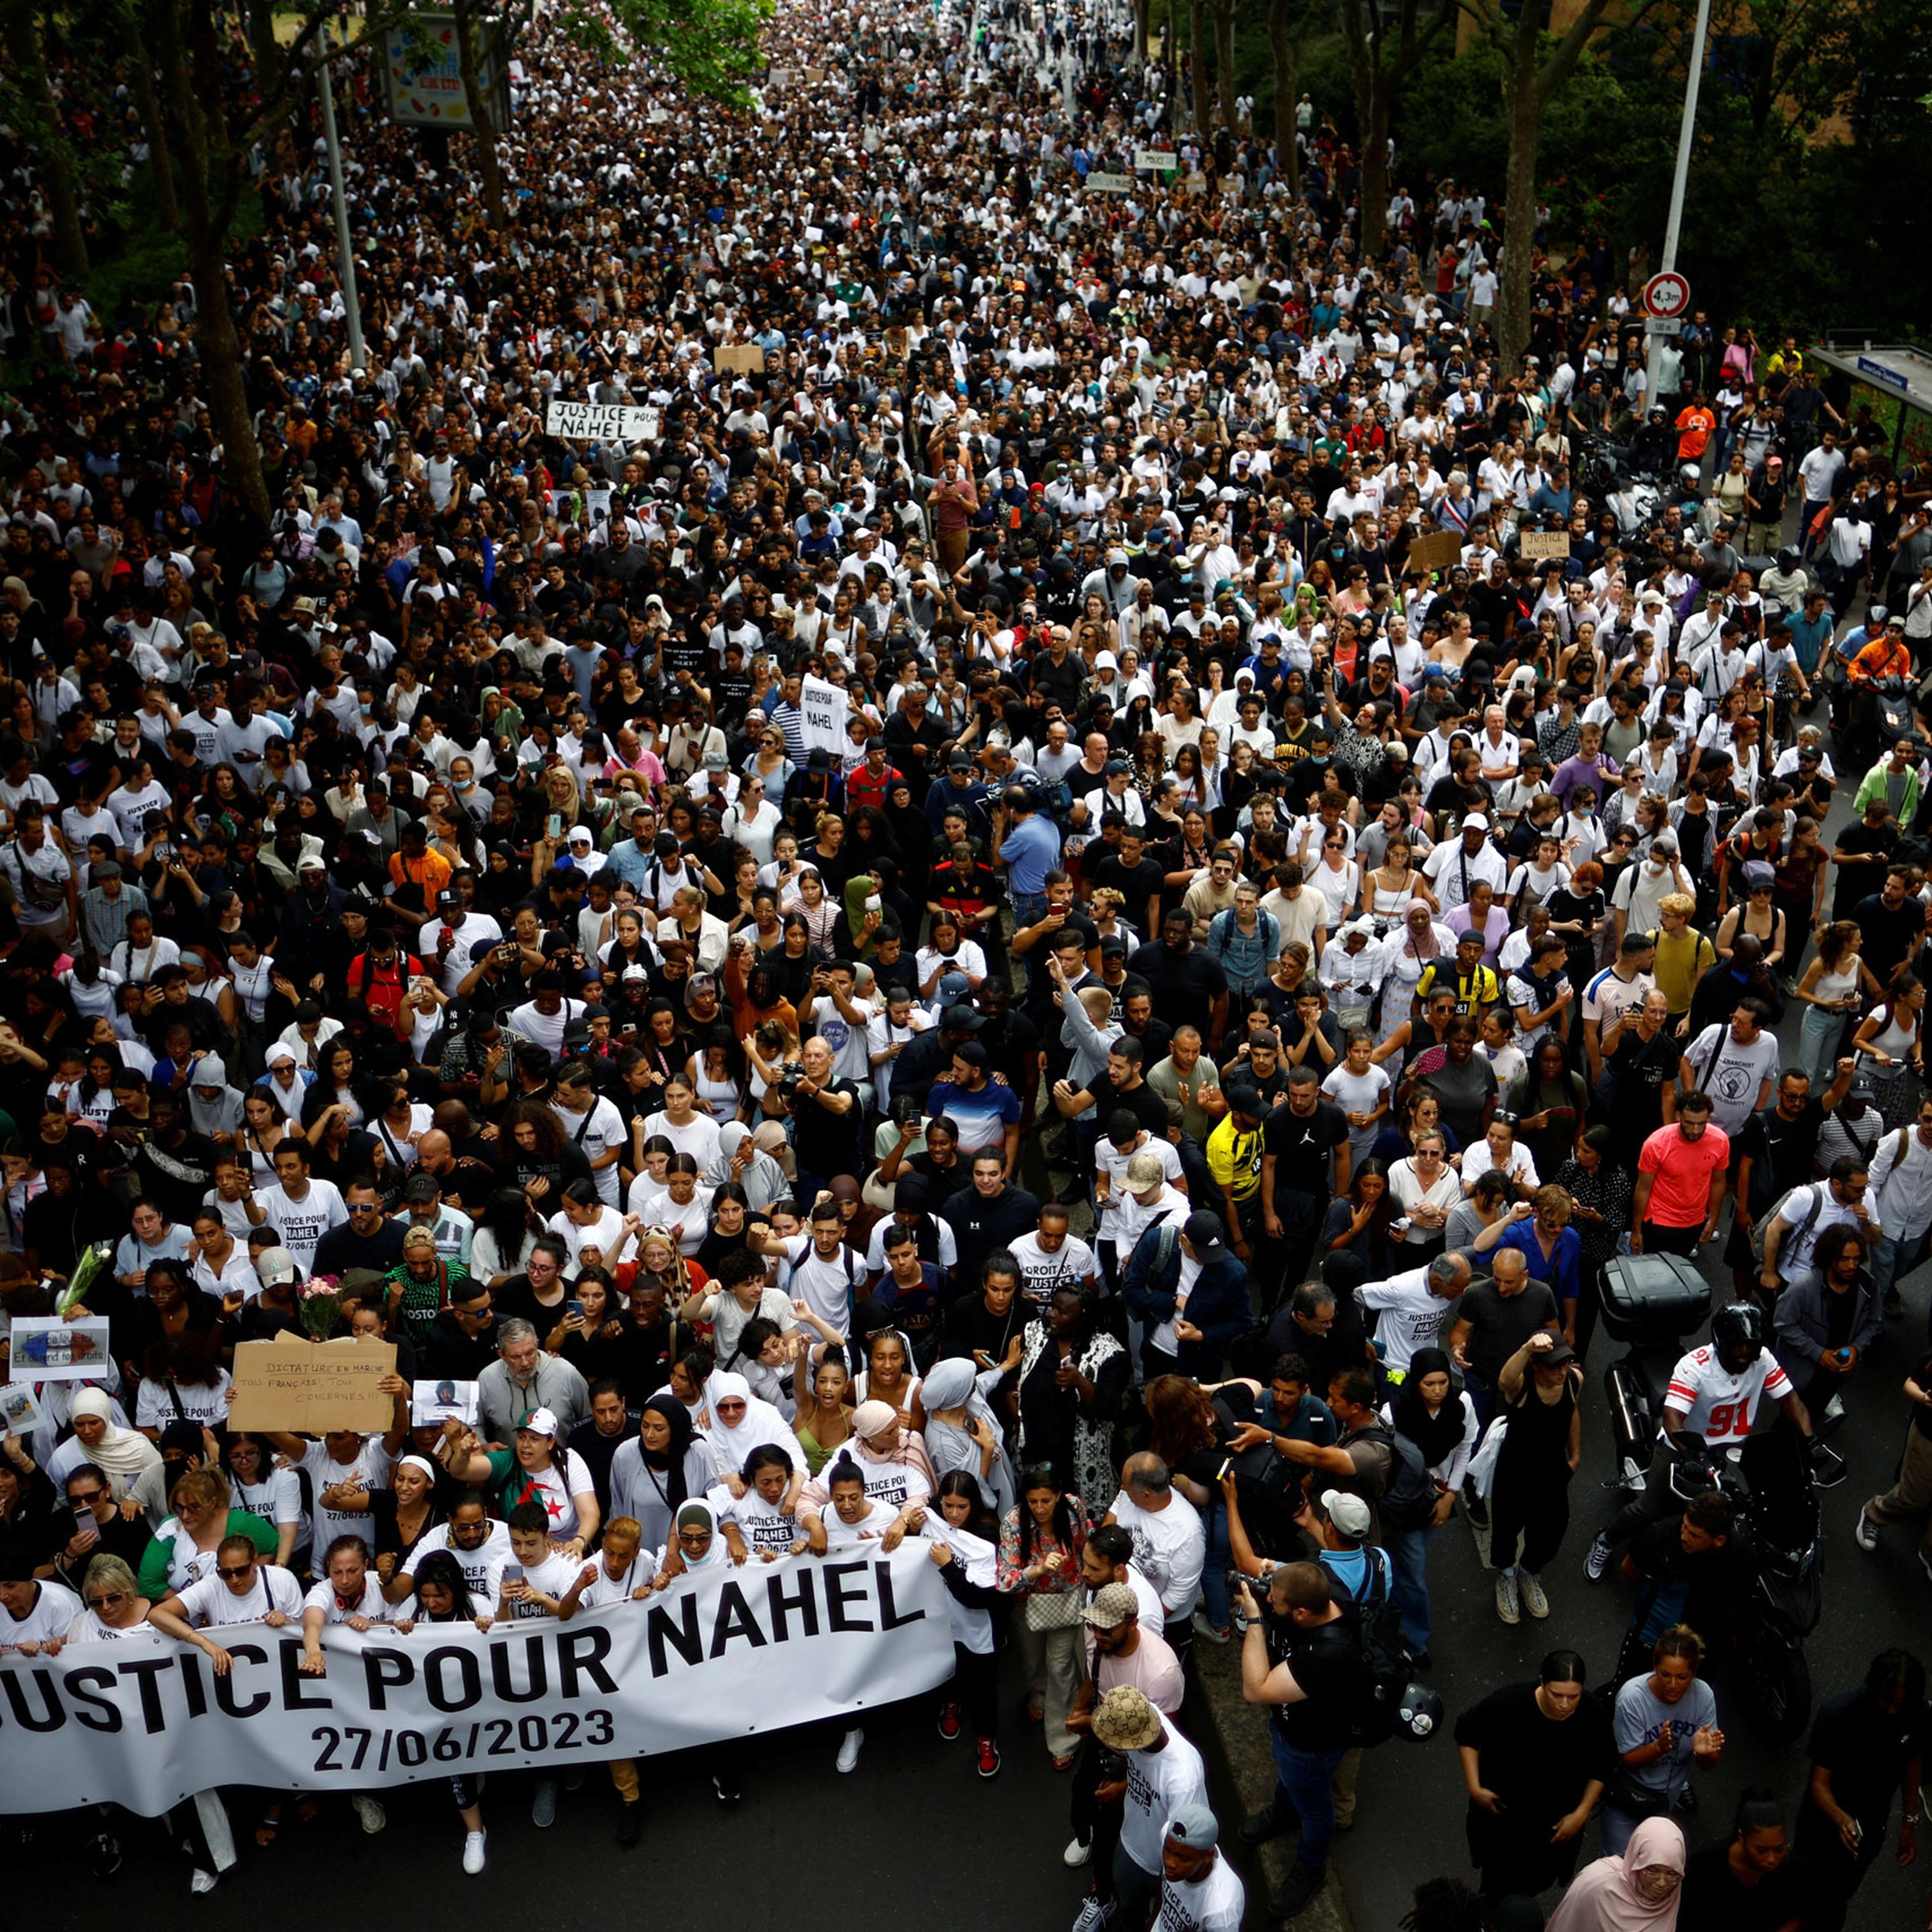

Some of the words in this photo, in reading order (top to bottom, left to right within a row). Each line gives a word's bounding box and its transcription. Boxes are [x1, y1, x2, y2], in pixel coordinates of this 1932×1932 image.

[554, 404, 627, 421] JUSTICE
[560, 419, 627, 439] NAHEL
[1527, 533, 1562, 544] JUSTICE
[807, 711, 833, 730] NAHEL
[266, 1363, 333, 1373] DICTATURE
[1706, 1396, 1753, 1437] 91
[647, 1560, 925, 1678] NAHEL
[0, 1640, 332, 1734] USTICE
[361, 1626, 619, 1712] POUR
[311, 1710, 614, 1773] 27/06/2023
